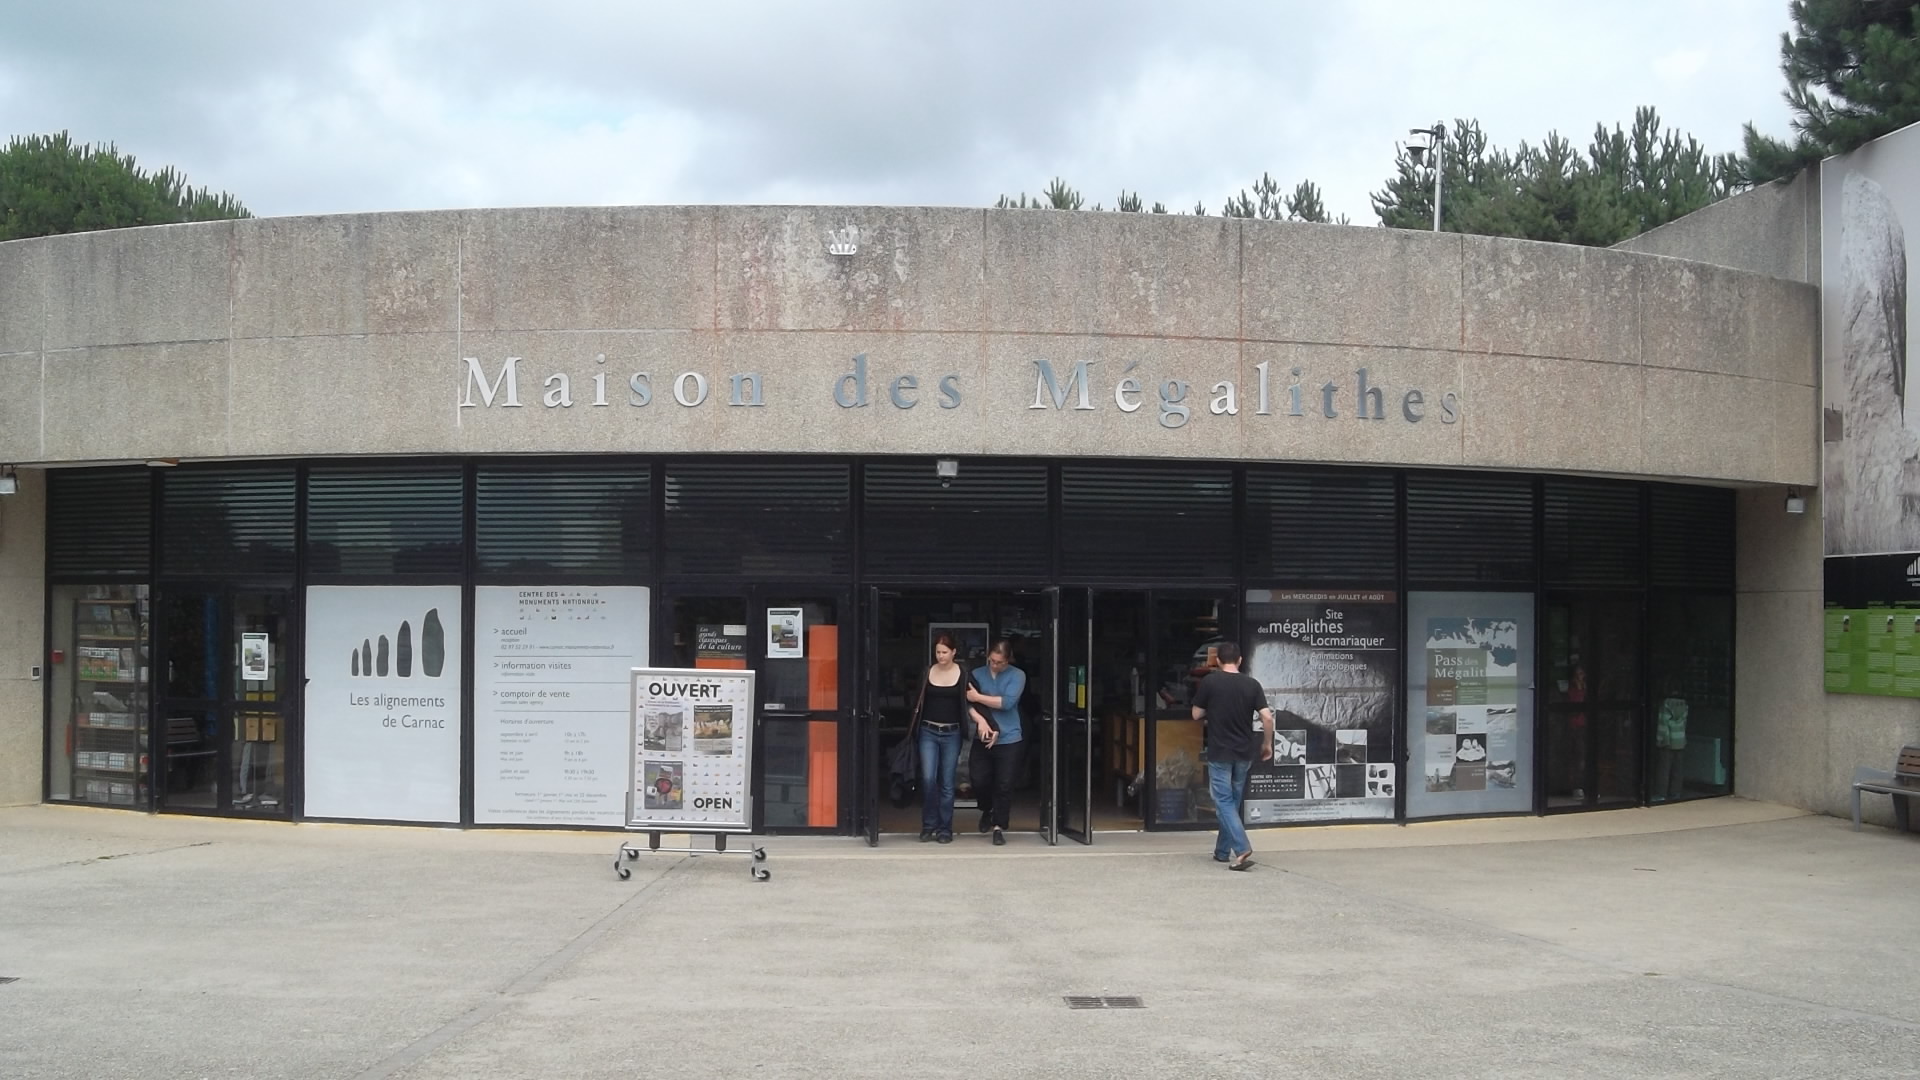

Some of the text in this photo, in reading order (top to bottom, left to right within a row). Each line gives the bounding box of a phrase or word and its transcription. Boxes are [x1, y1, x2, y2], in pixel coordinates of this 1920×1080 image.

[458, 354, 1461, 429] Maison des Mégalithes
[1326, 608, 1344, 620] Site
[501, 628, 527, 636] accueil
[1269, 618, 1344, 638] mégalithes
[1310, 635, 1384, 649] Locmariaquer
[1311, 652, 1354, 660] Animations
[1434, 654, 1478, 666] Pass des
[501, 661, 572, 670] information visites
[1434, 667, 1486, 680] Mégalit
[500, 690, 535, 699] comptoir
[538, 690, 547, 698] de
[648, 682, 721, 698] OUVERT
[350, 692, 445, 710] Les alignements
[382, 714, 445, 728] de Carnac
[694, 797, 732, 809] OPEN
